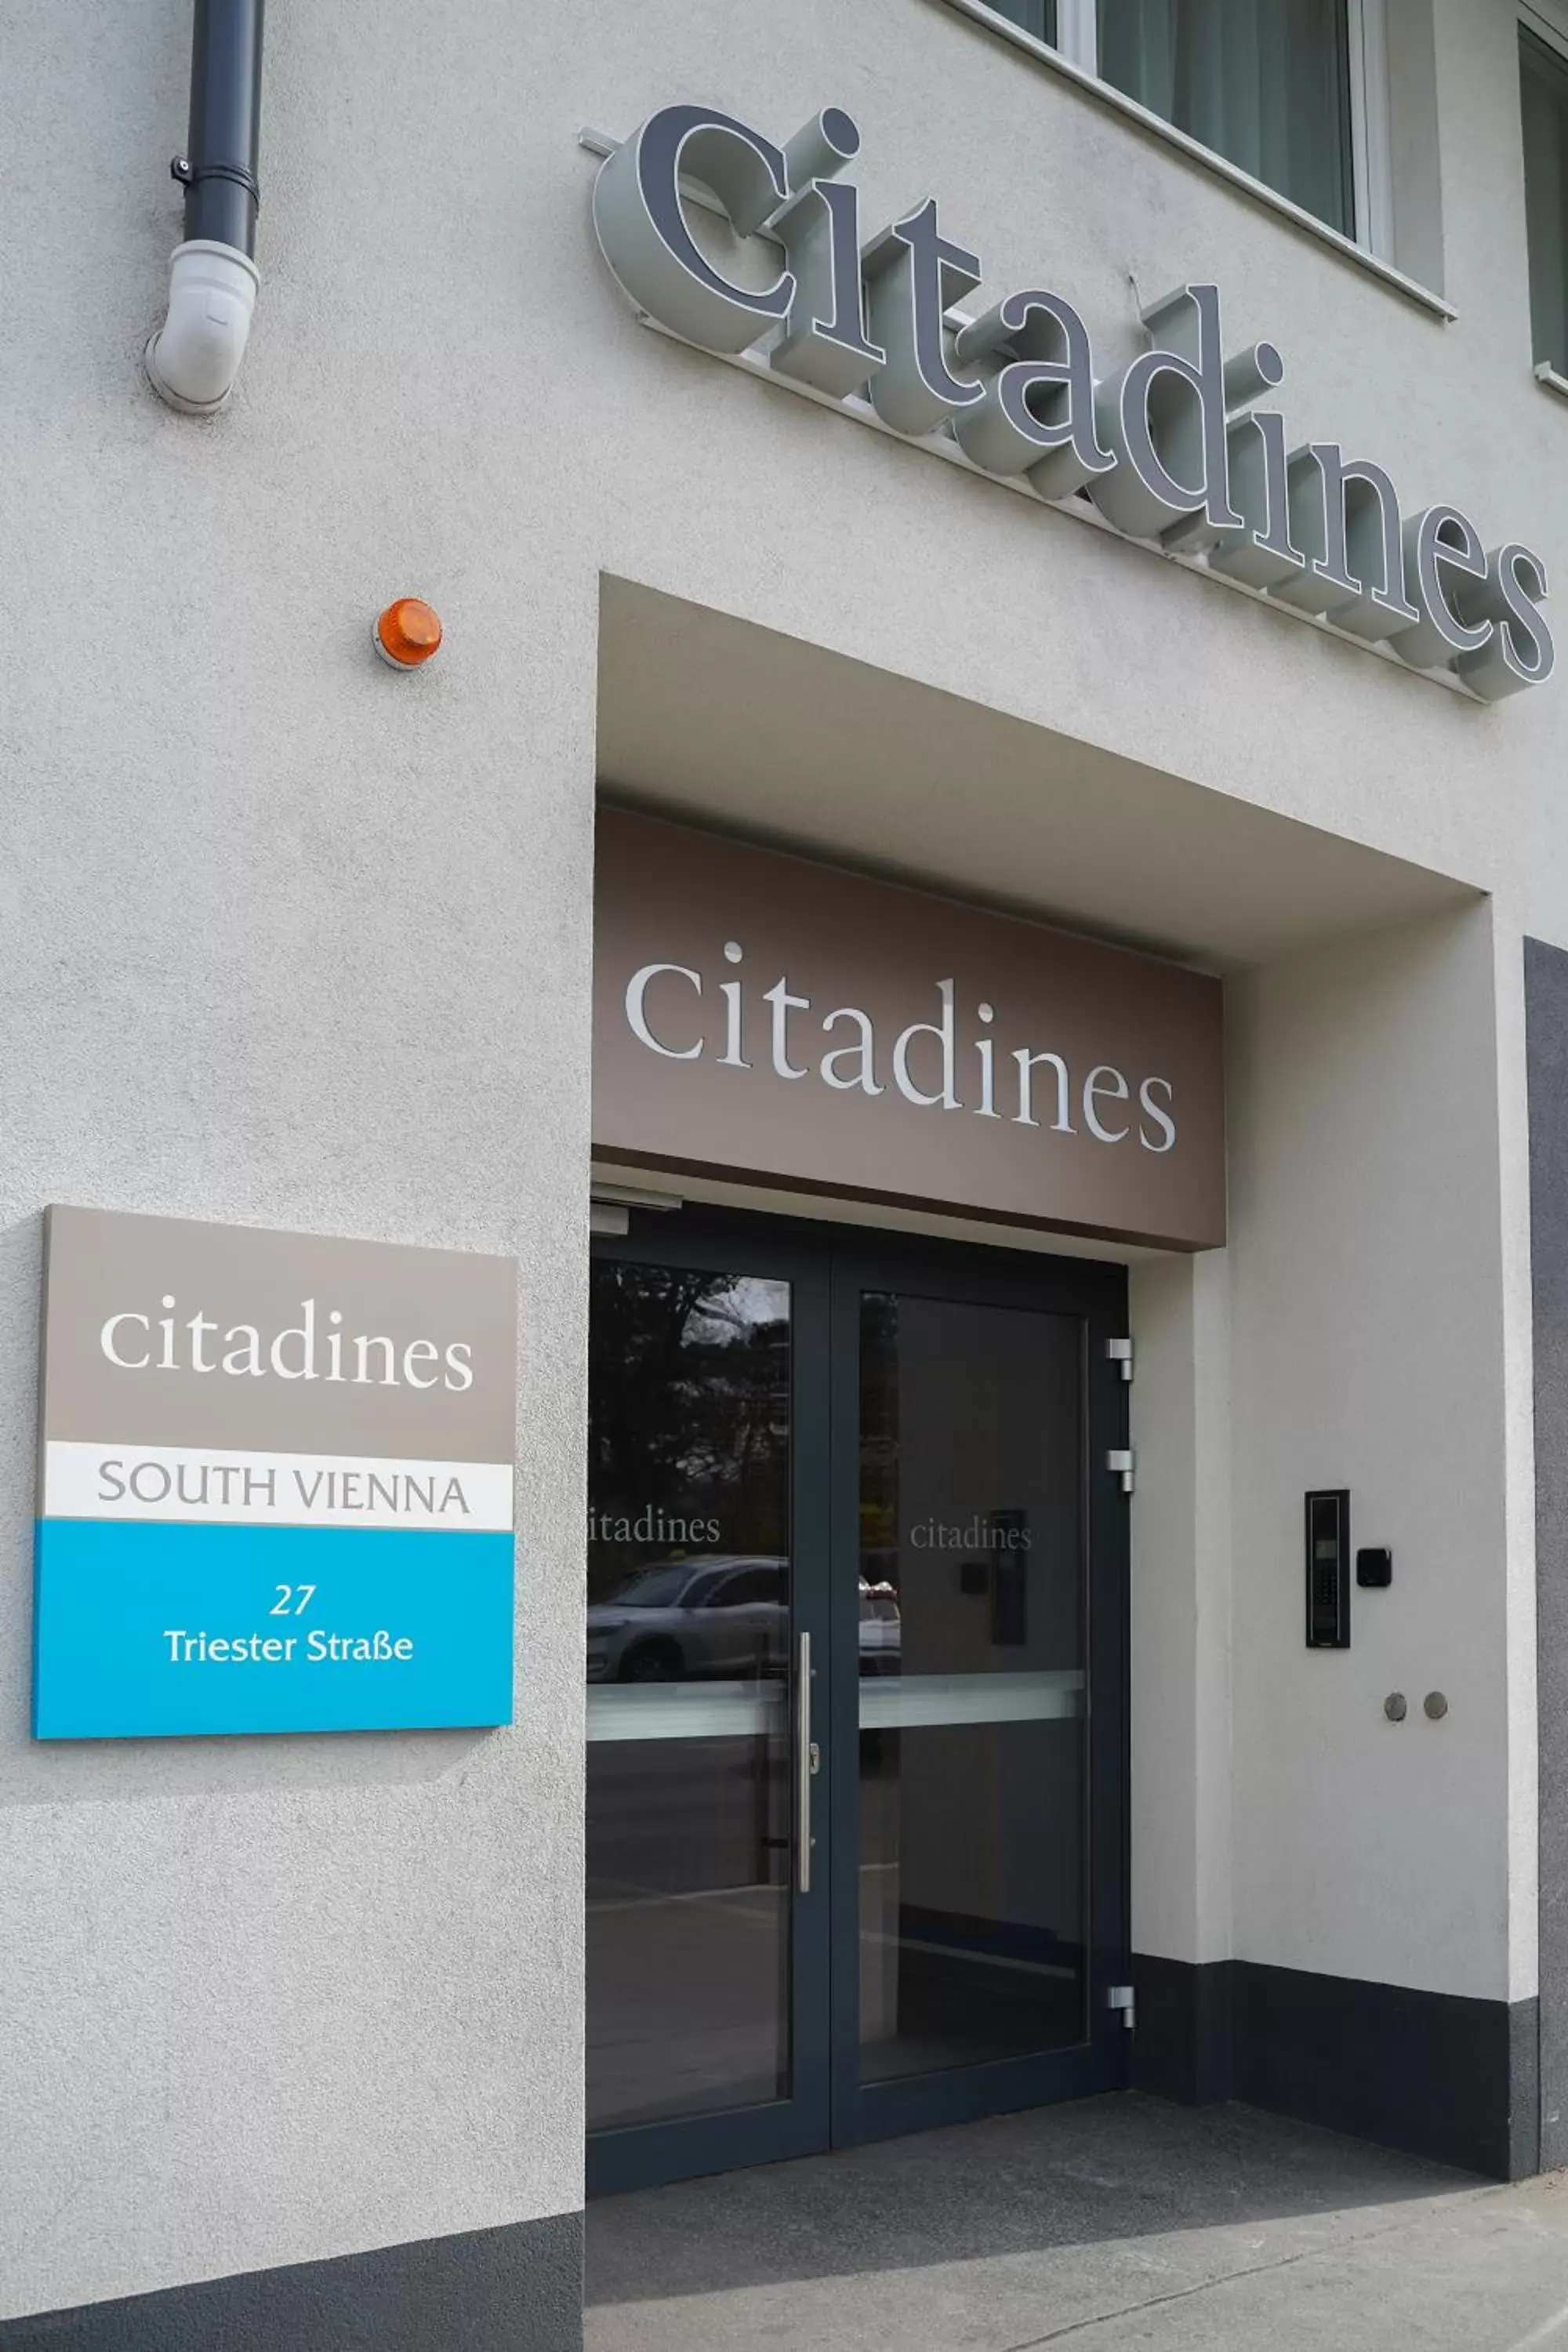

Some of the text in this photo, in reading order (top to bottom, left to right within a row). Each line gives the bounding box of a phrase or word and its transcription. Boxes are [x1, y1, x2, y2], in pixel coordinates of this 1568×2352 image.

[624, 940, 1177, 1153] citadines
[100, 1294, 474, 1392] citadines
[97, 1460, 472, 1515] SOUTH VIENNA
[588, 1503, 720, 1543] itadines
[909, 1514, 1033, 1552] citadines
[269, 1584, 317, 1616] 27
[162, 1629, 414, 1662] Triester Straße
